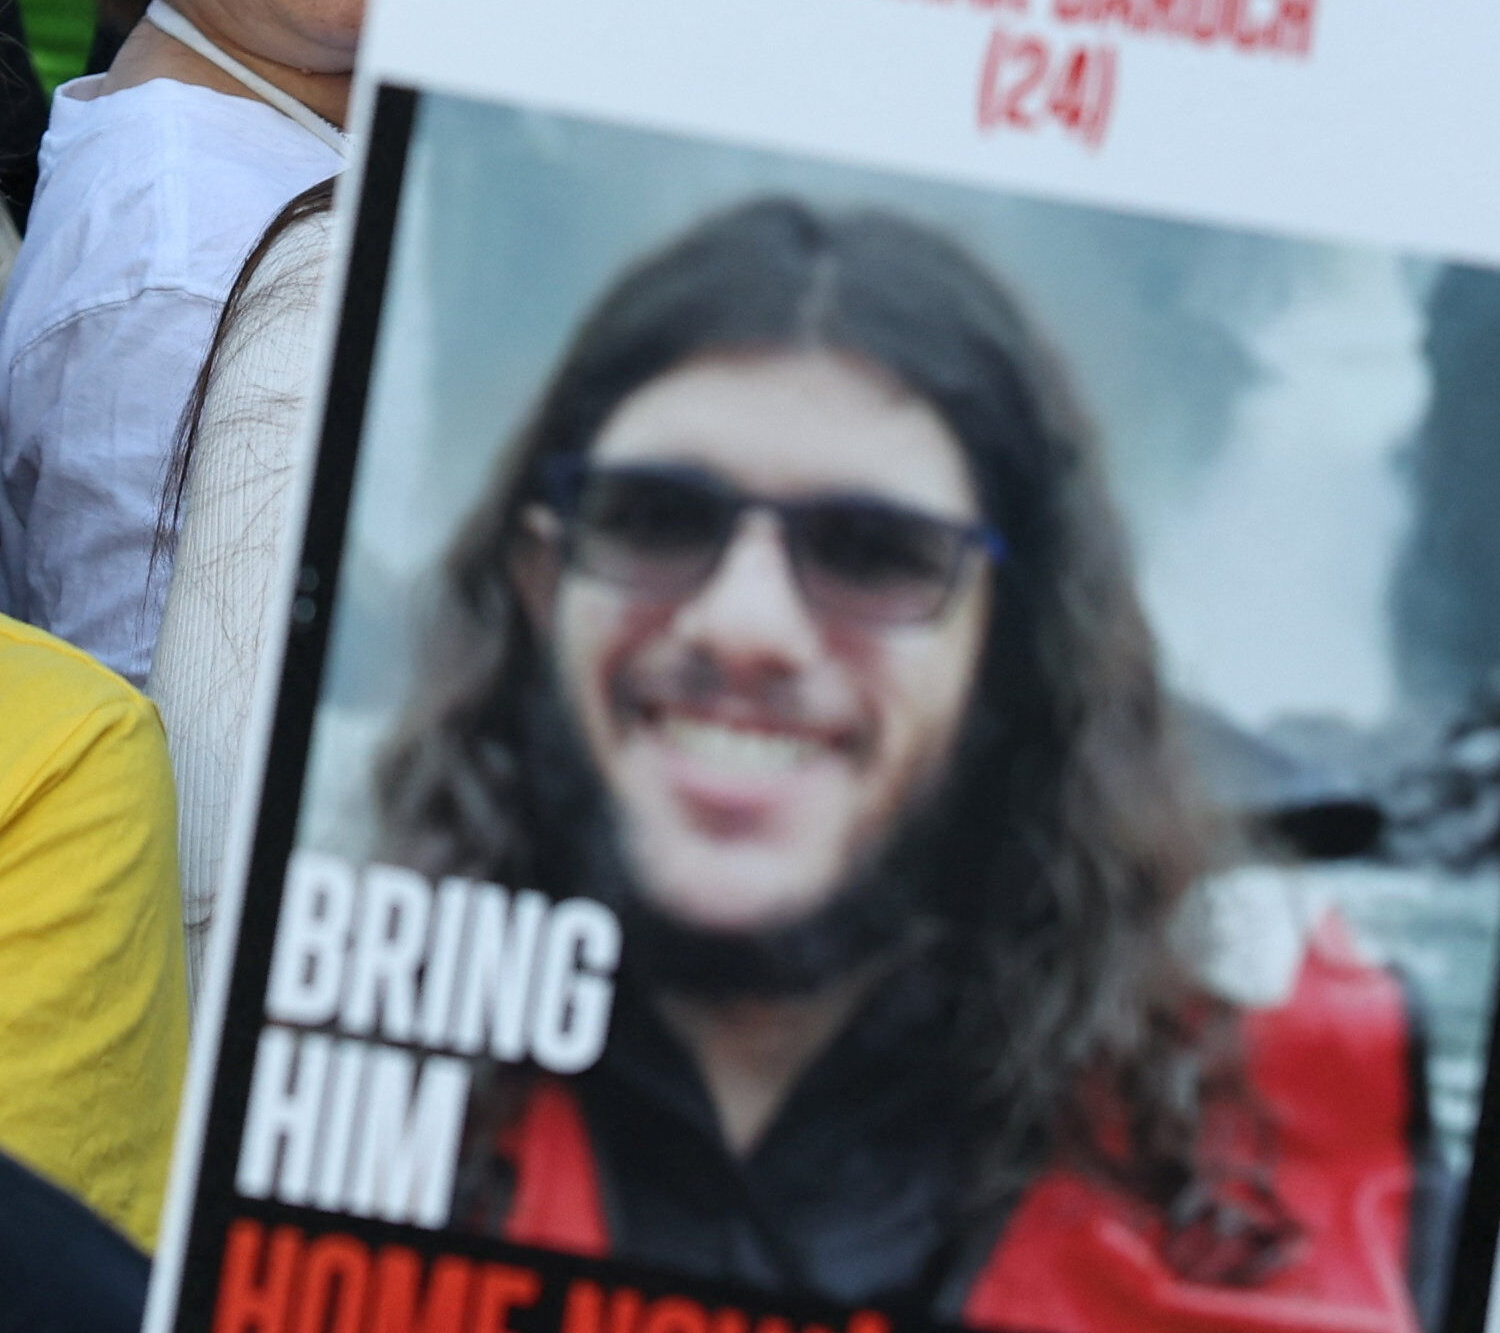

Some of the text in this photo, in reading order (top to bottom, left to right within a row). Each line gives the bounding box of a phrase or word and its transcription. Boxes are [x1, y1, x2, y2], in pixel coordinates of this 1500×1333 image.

[976, 26, 1118, 151] (24)
[264, 849, 624, 1075] BRING
[234, 1021, 473, 1232] HIM
